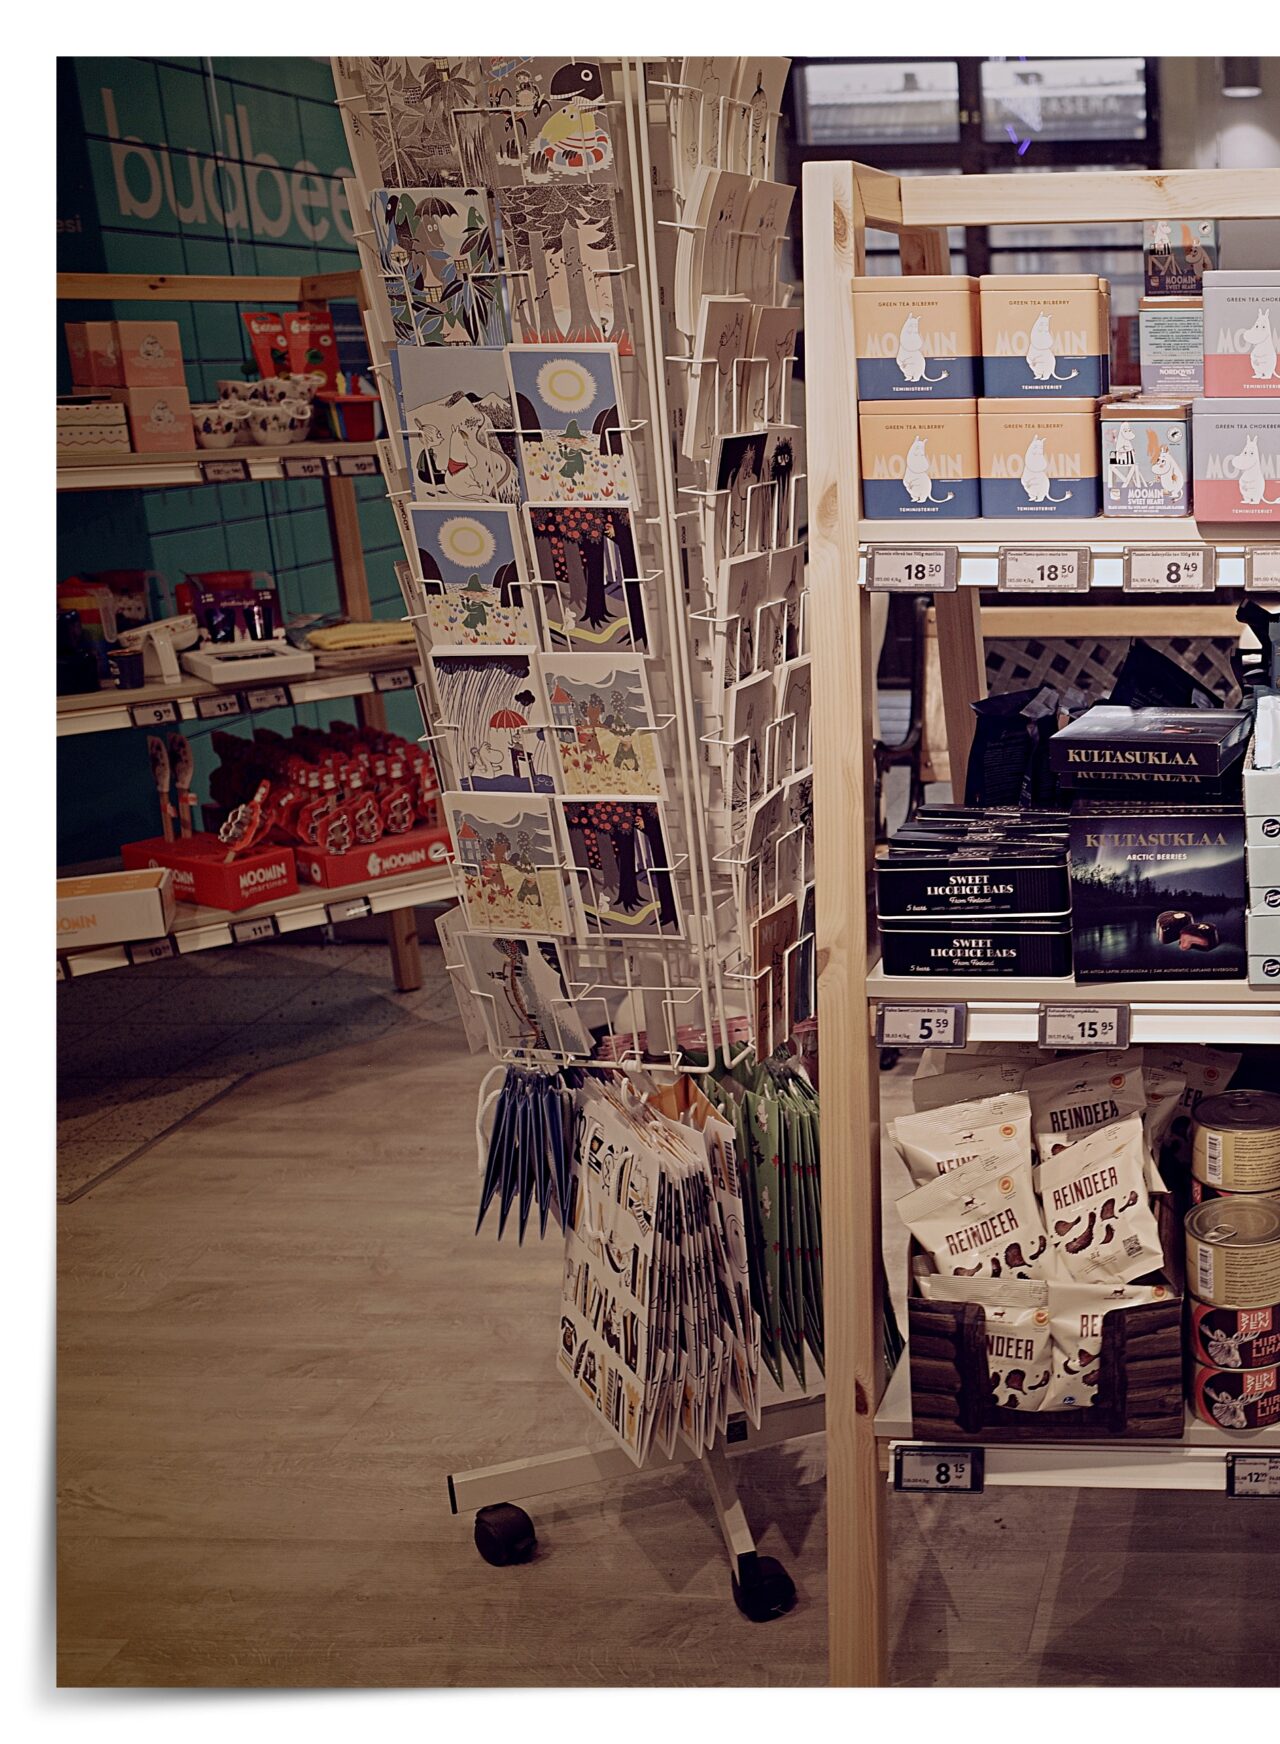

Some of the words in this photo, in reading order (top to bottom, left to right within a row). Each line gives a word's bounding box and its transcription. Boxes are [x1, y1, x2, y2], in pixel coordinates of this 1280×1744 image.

[101, 87, 357, 245] budbee
[1166, 275, 1197, 285] MOOMIN
[1128, 488, 1164, 499] MOOMIN
[905, 564, 926, 581] 18
[929, 564, 942, 573] 50
[1037, 565, 1059, 581] 18
[1062, 565, 1074, 574] 50
[1167, 562, 1181, 583] 8
[1184, 562, 1198, 571] 49
[153, 710, 163, 722] 9
[1067, 749, 1198, 766] KULTASUKLAA
[1085, 832, 1227, 848] KULTASUKLAA
[382, 848, 426, 870] MOOMIN
[1156, 853, 1188, 861] BERRIES
[239, 862, 287, 889] MOOMIN
[949, 875, 989, 885] SWEET
[926, 886, 981, 896] LICORICE
[983, 884, 1014, 894] BARS
[952, 939, 993, 948] SWEET
[930, 948, 984, 957] LICORICE
[986, 949, 1017, 958] BARS
[919, 1018, 933, 1040] 5
[936, 1019, 949, 1028] 59
[1078, 1022, 1098, 1038] 15
[1102, 1022, 1114, 1031] 95
[1050, 1101, 1119, 1133] REINDEER
[1053, 1166, 1119, 1211] REINDEER
[945, 1207, 1019, 1256] REINDEER
[936, 1463, 950, 1484] 8
[1248, 1472, 1261, 1483] 12
